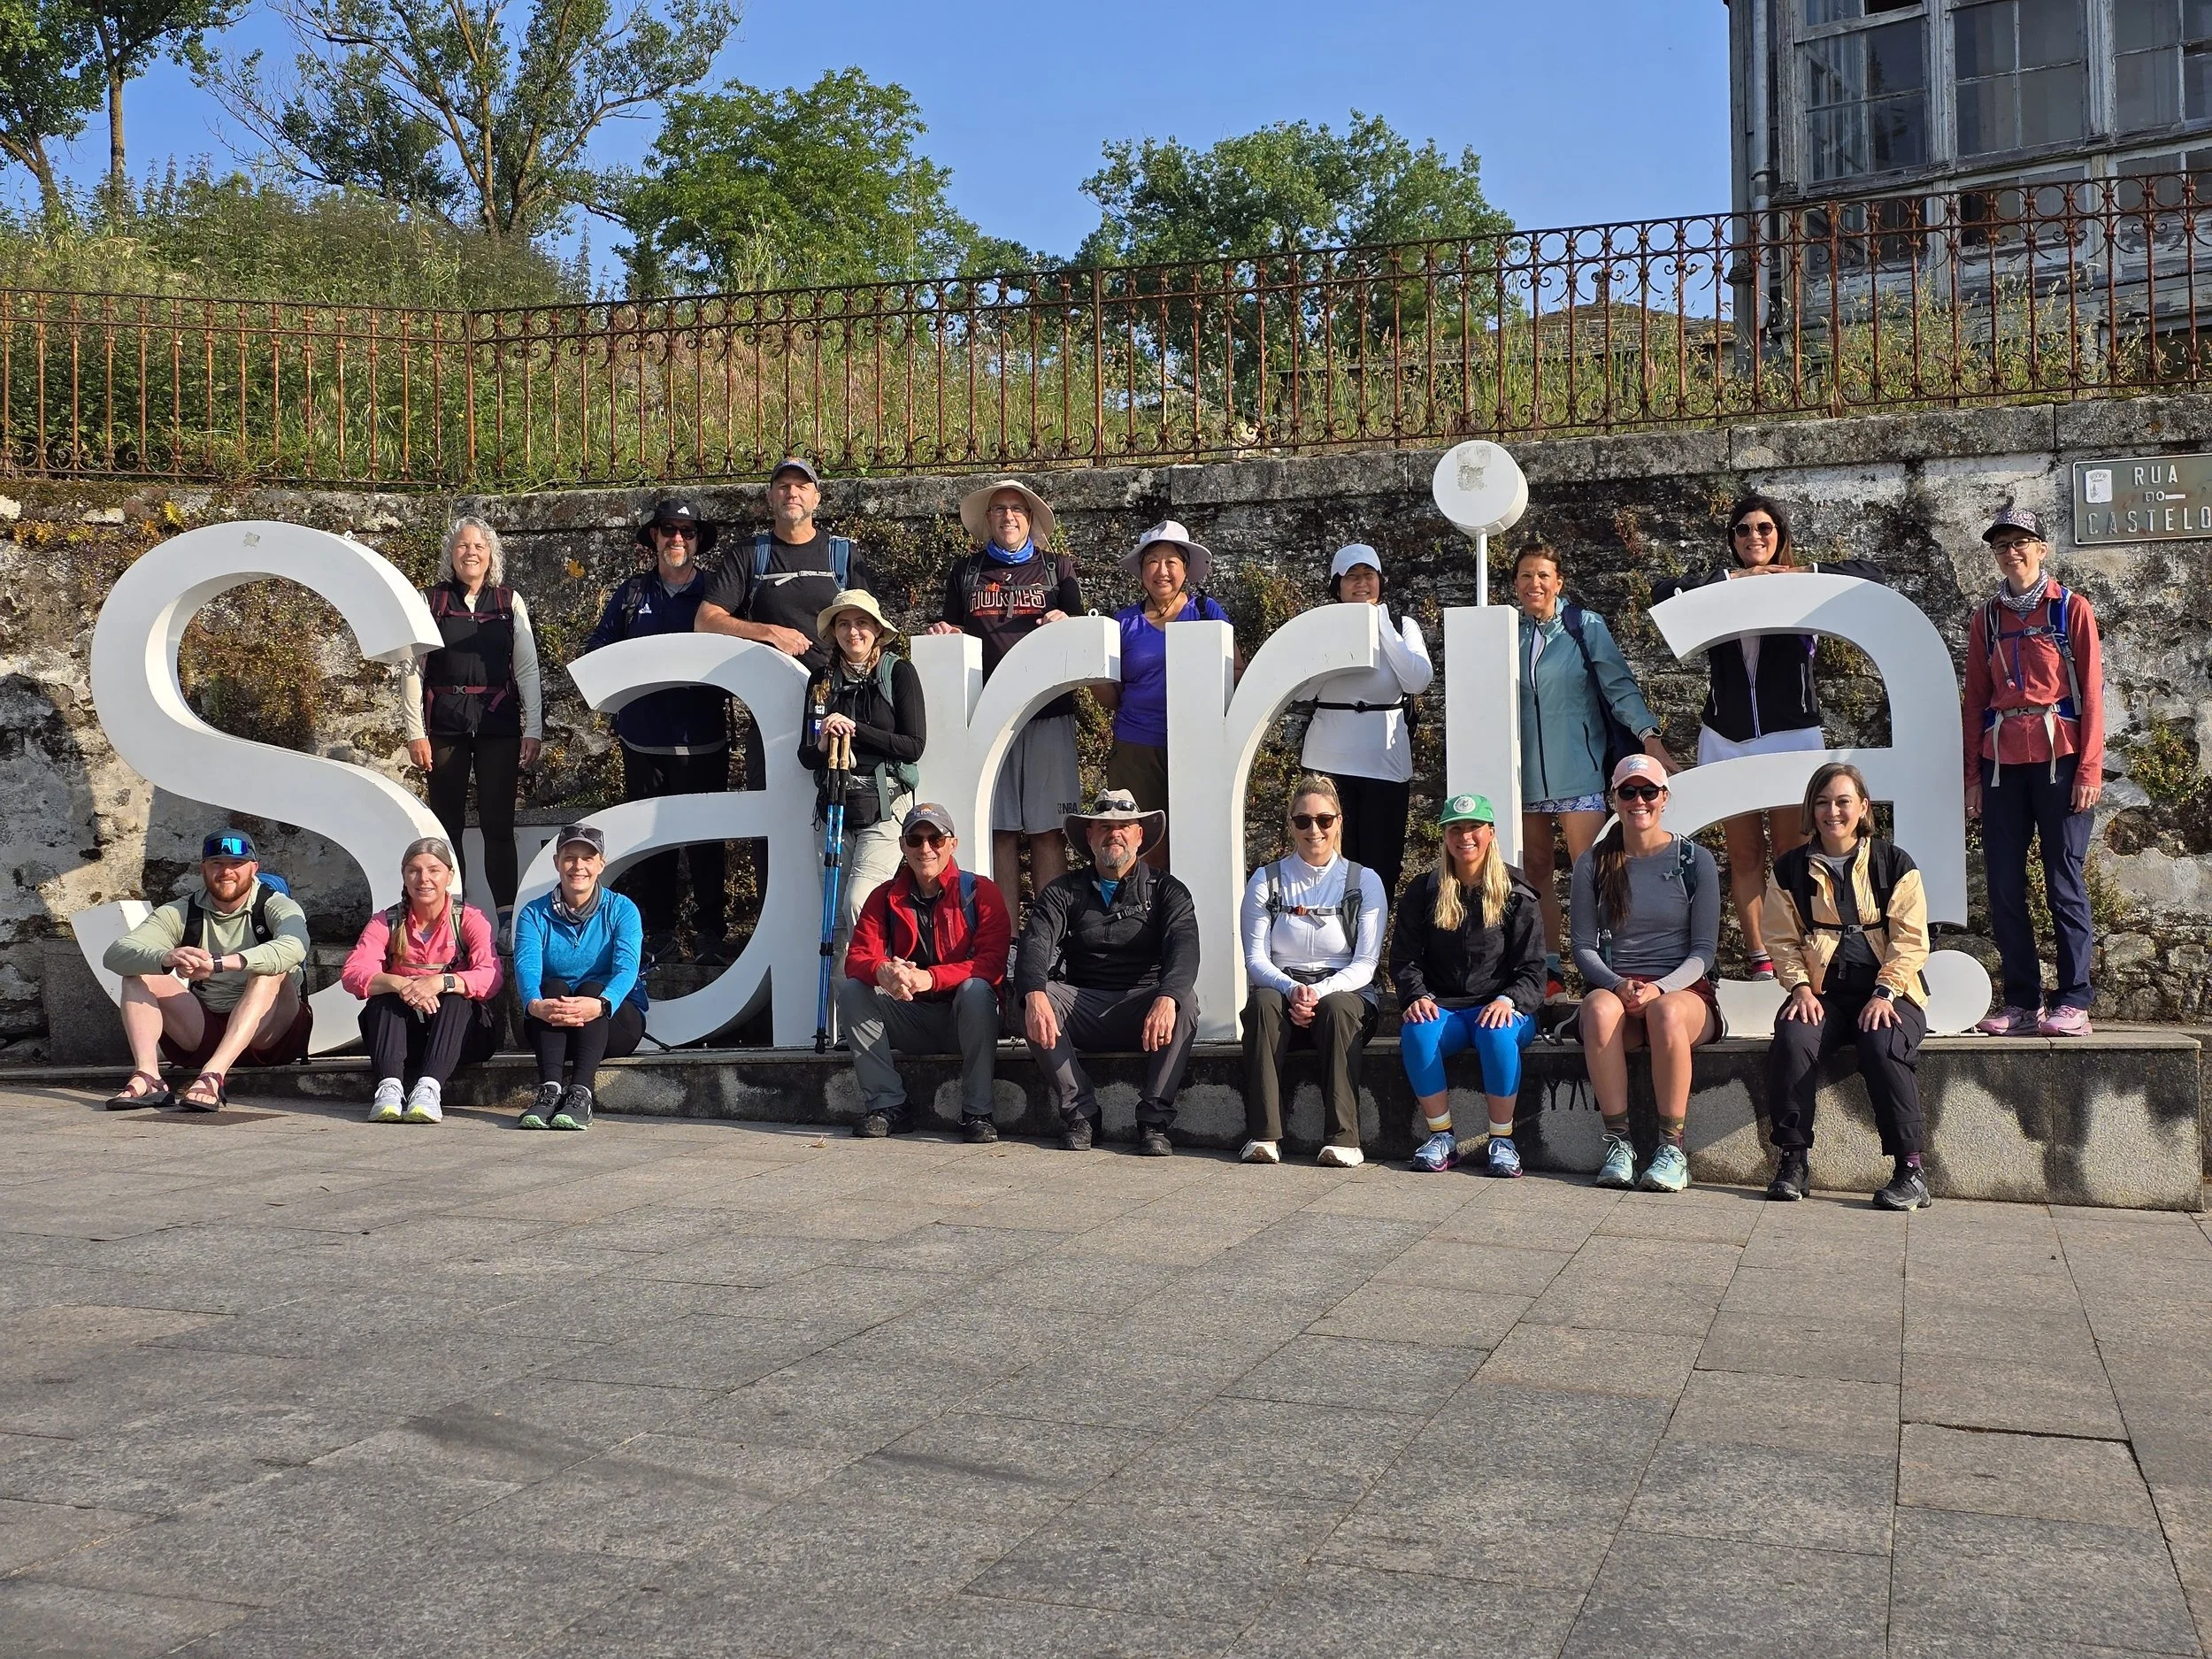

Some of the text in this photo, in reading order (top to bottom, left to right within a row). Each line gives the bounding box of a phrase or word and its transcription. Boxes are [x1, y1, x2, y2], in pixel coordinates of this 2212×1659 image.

[2133, 465, 2178, 486] RUA
[2145, 490, 2165, 502] DO
[2087, 506, 2211, 534] CASTELO
